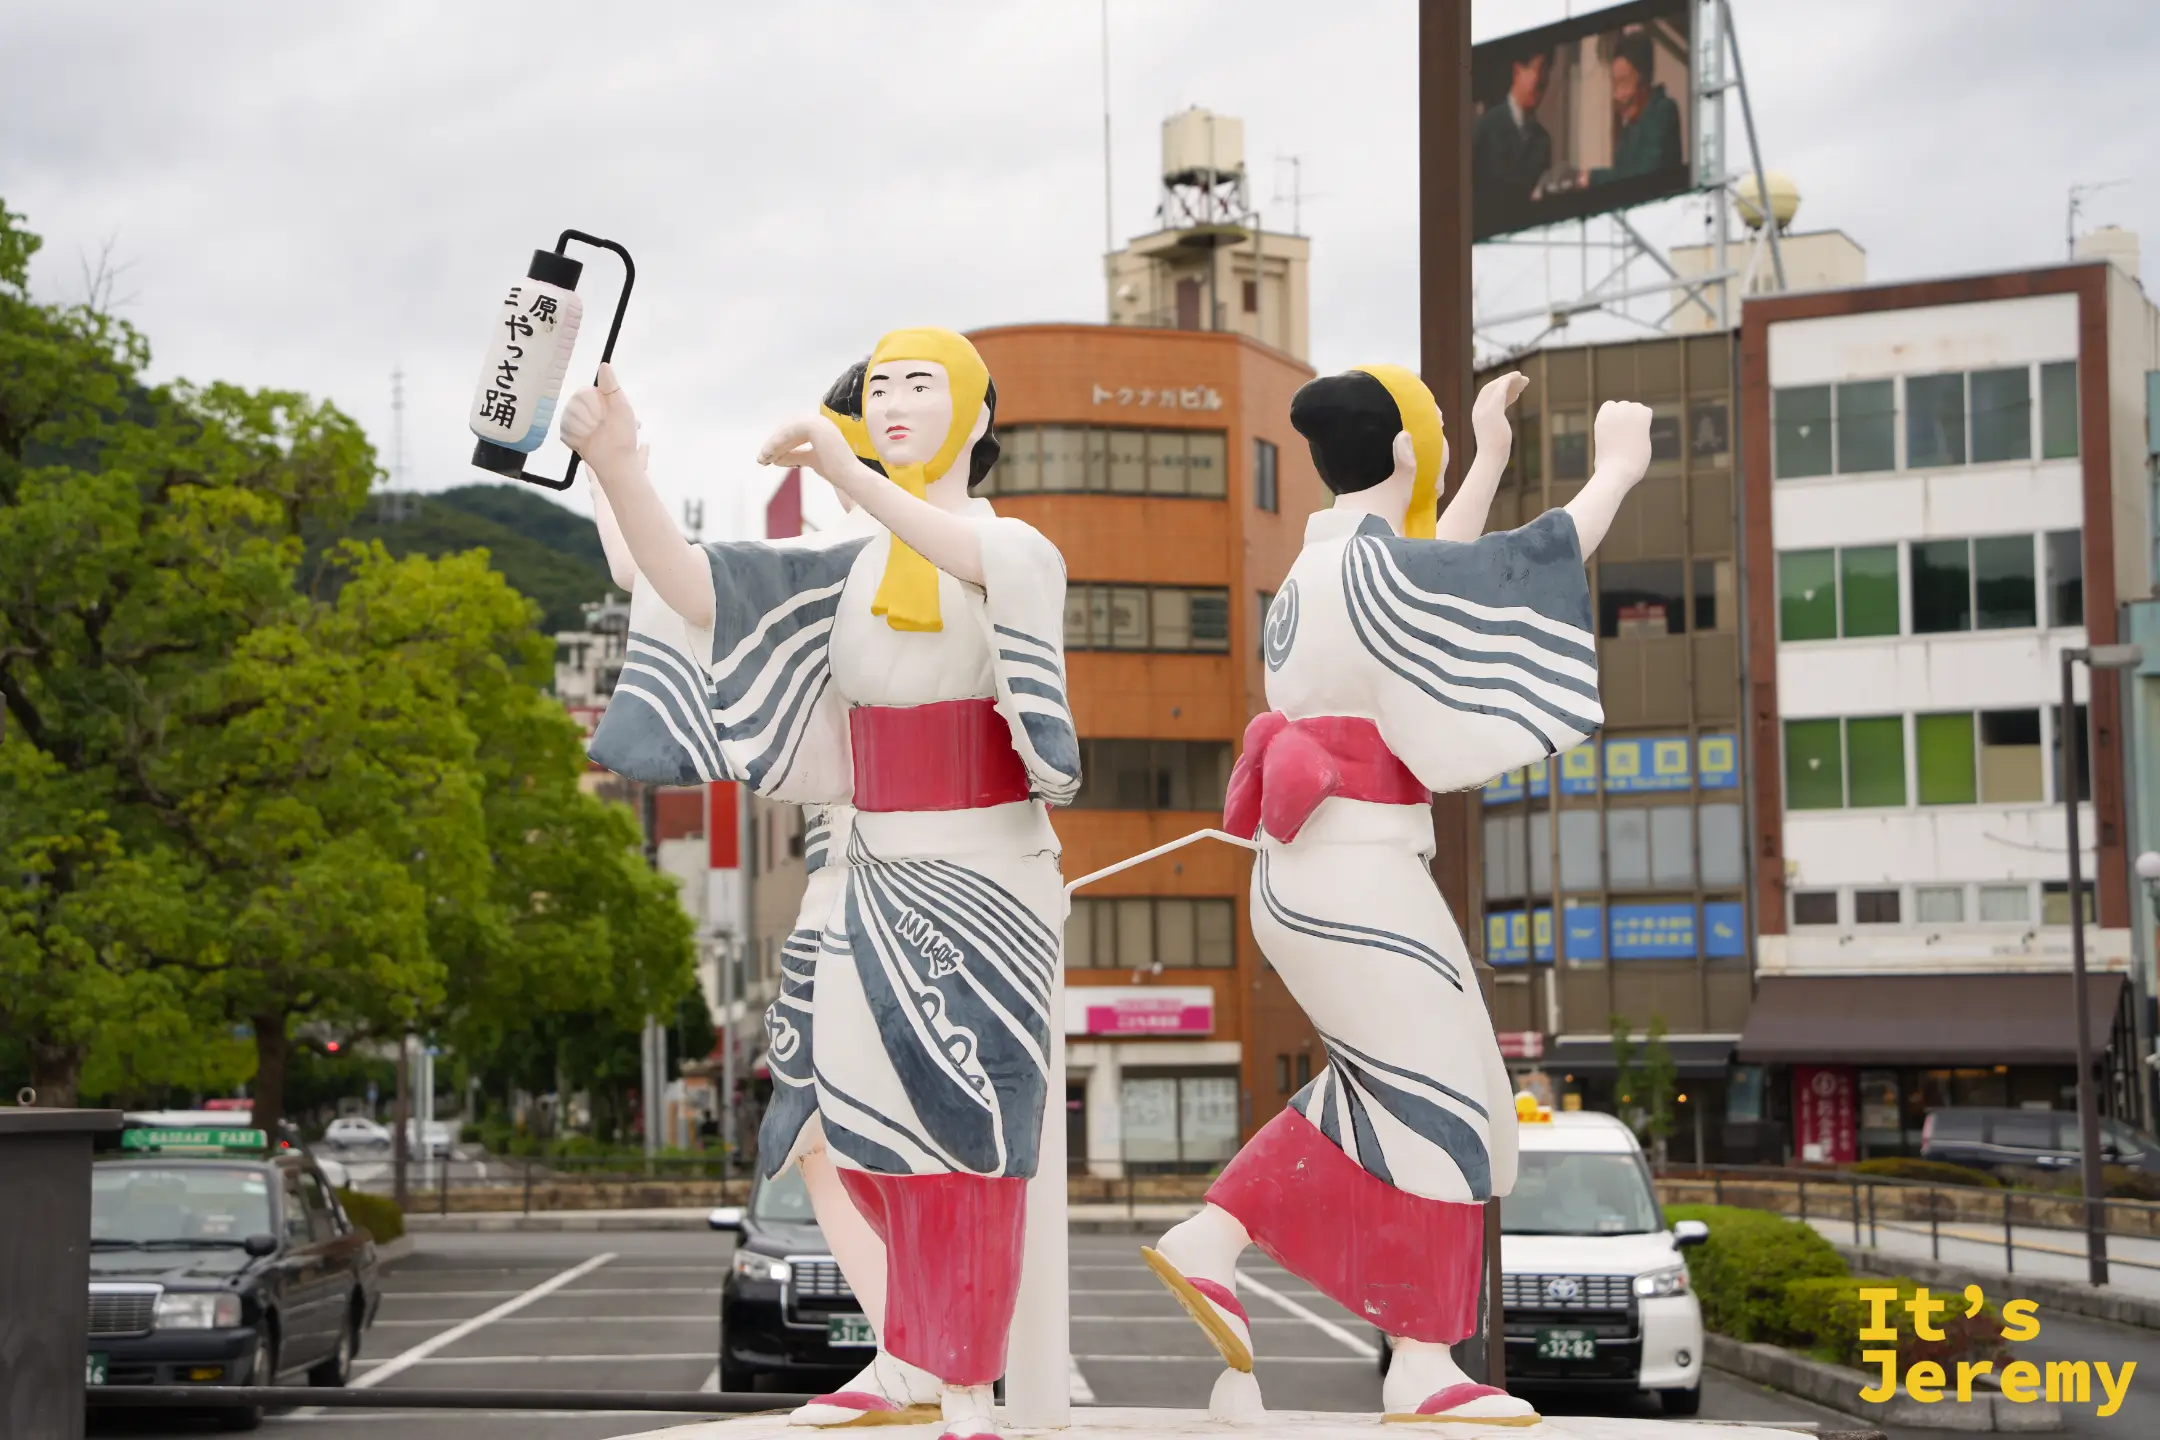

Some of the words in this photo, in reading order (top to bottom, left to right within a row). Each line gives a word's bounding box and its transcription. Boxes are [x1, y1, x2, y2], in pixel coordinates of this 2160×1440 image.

[479, 313, 534, 430] やっさ踊
[1091, 382, 1223, 411] トクナガビル
[218, 1131, 255, 1144] TAXI
